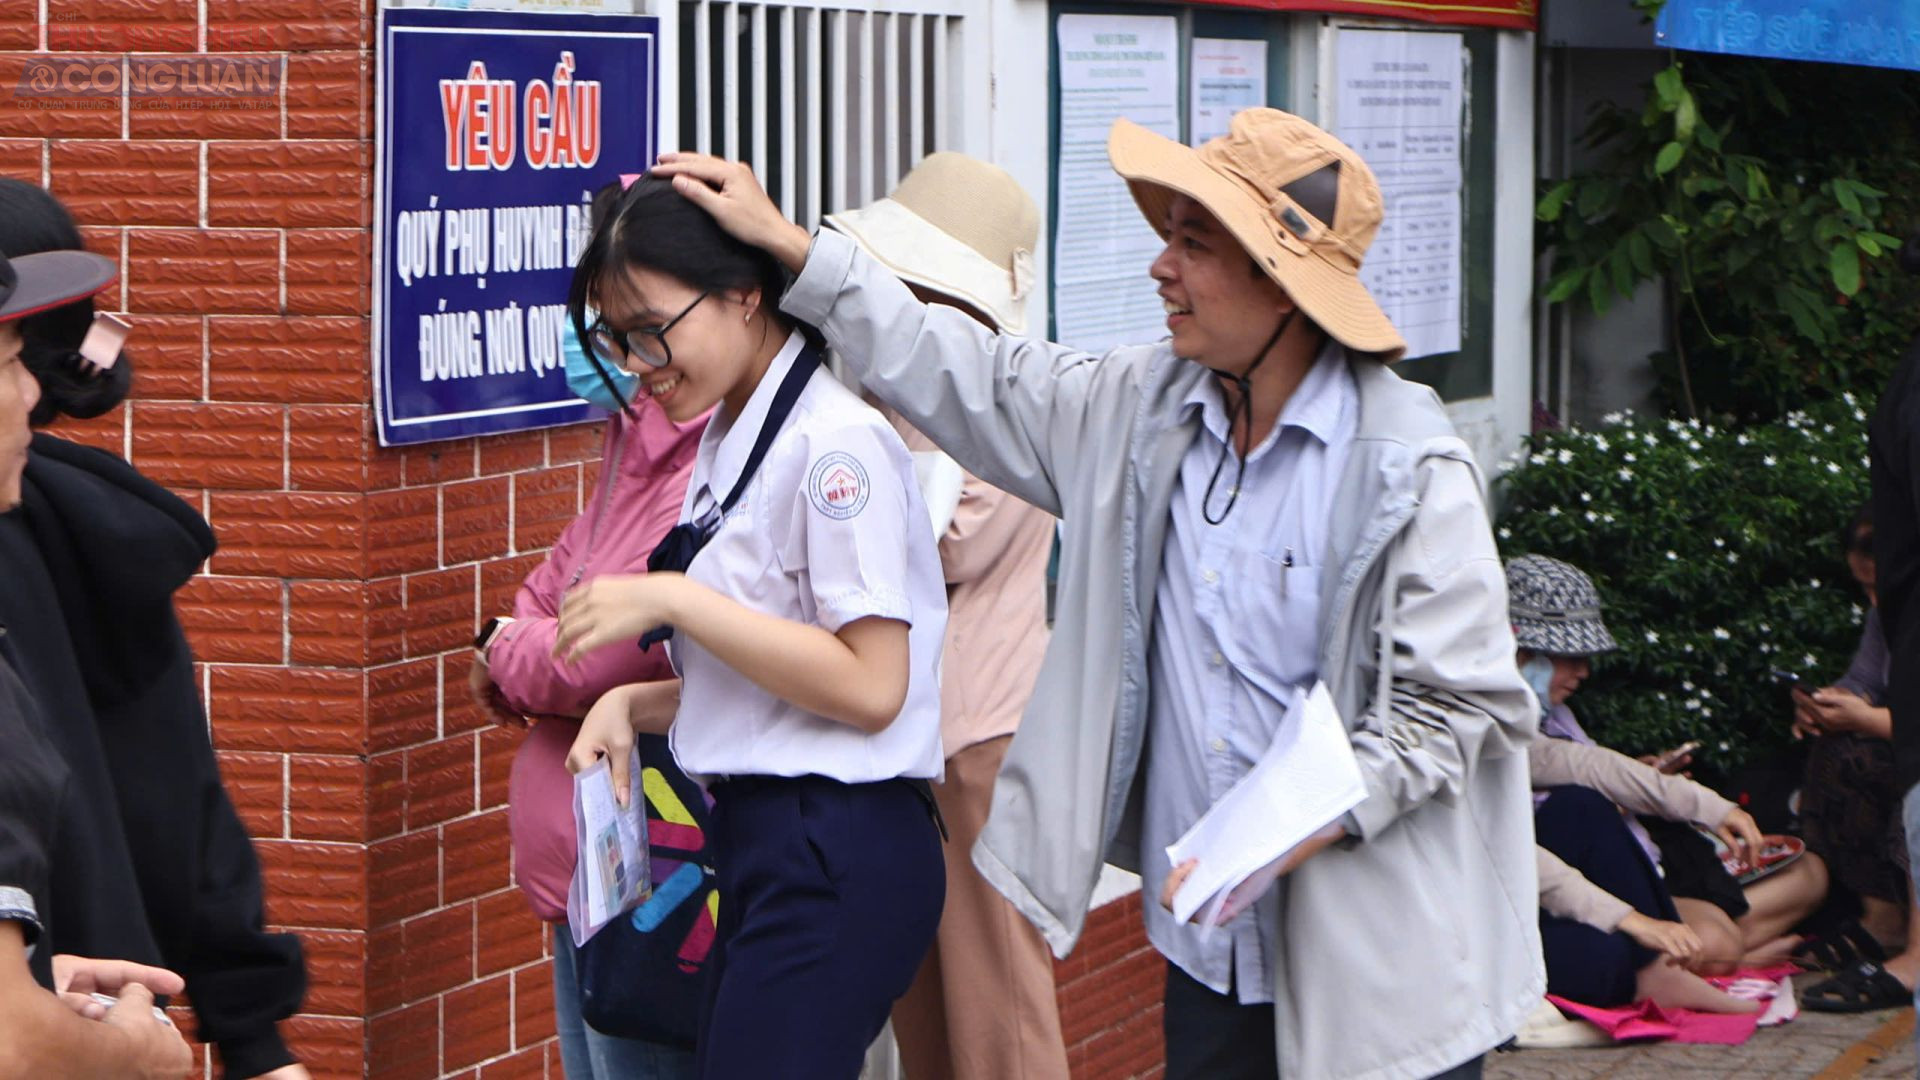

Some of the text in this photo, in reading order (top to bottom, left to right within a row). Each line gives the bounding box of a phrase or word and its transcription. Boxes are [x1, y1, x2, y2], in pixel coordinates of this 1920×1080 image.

[439, 50, 601, 171] YÊU CẦU
[397, 195, 441, 287] QUÝ
[444, 208, 490, 289] PHỤ
[494, 205, 563, 273] HUYNH
[418, 298, 483, 382] ĐÚNG
[485, 301, 525, 376] NƠI
